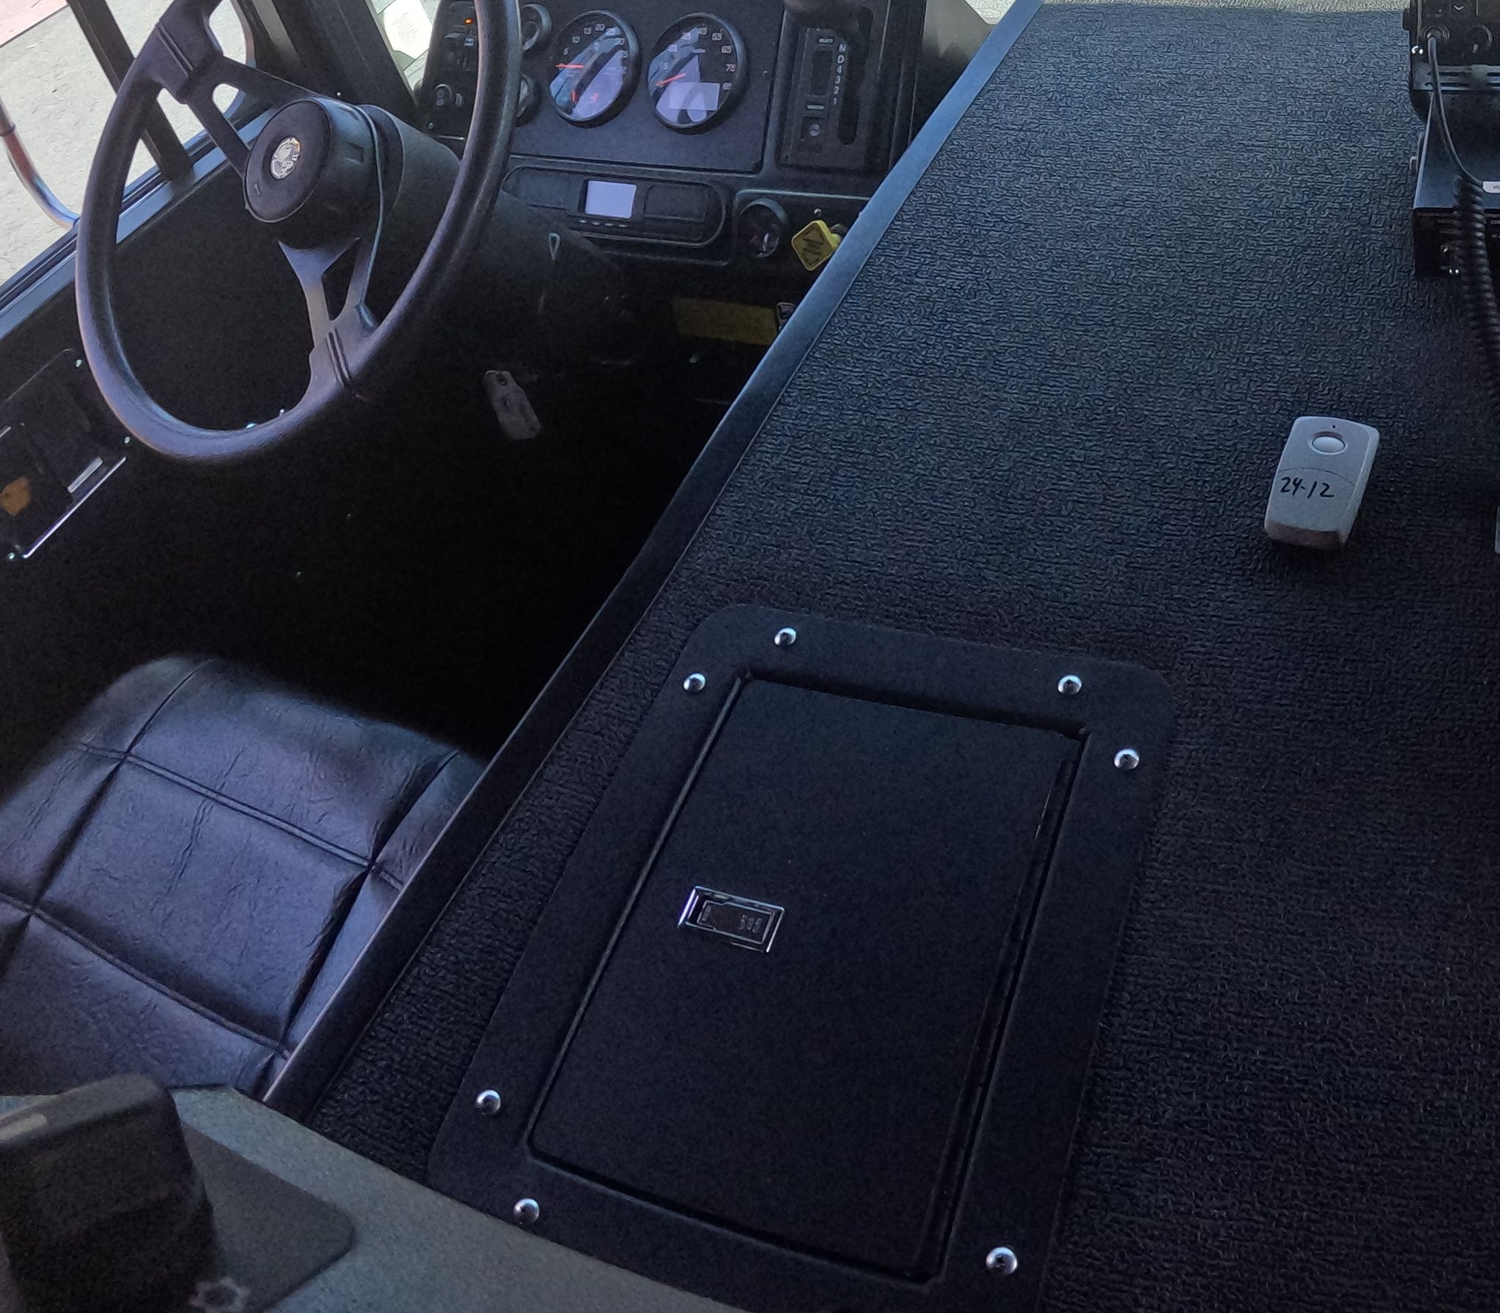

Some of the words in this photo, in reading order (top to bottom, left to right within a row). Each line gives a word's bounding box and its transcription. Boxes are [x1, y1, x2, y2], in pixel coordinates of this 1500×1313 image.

[595, 23, 605, 31] 20
[572, 36, 580, 44] 10
[838, 44, 847, 52] N
[837, 55, 845, 64] D
[725, 64, 736, 72] 75
[836, 65, 843, 74] 4
[835, 76, 841, 84] 3
[833, 86, 839, 95] 2
[832, 97, 837, 105] 1
[1280, 477, 1335, 499] 24-12
